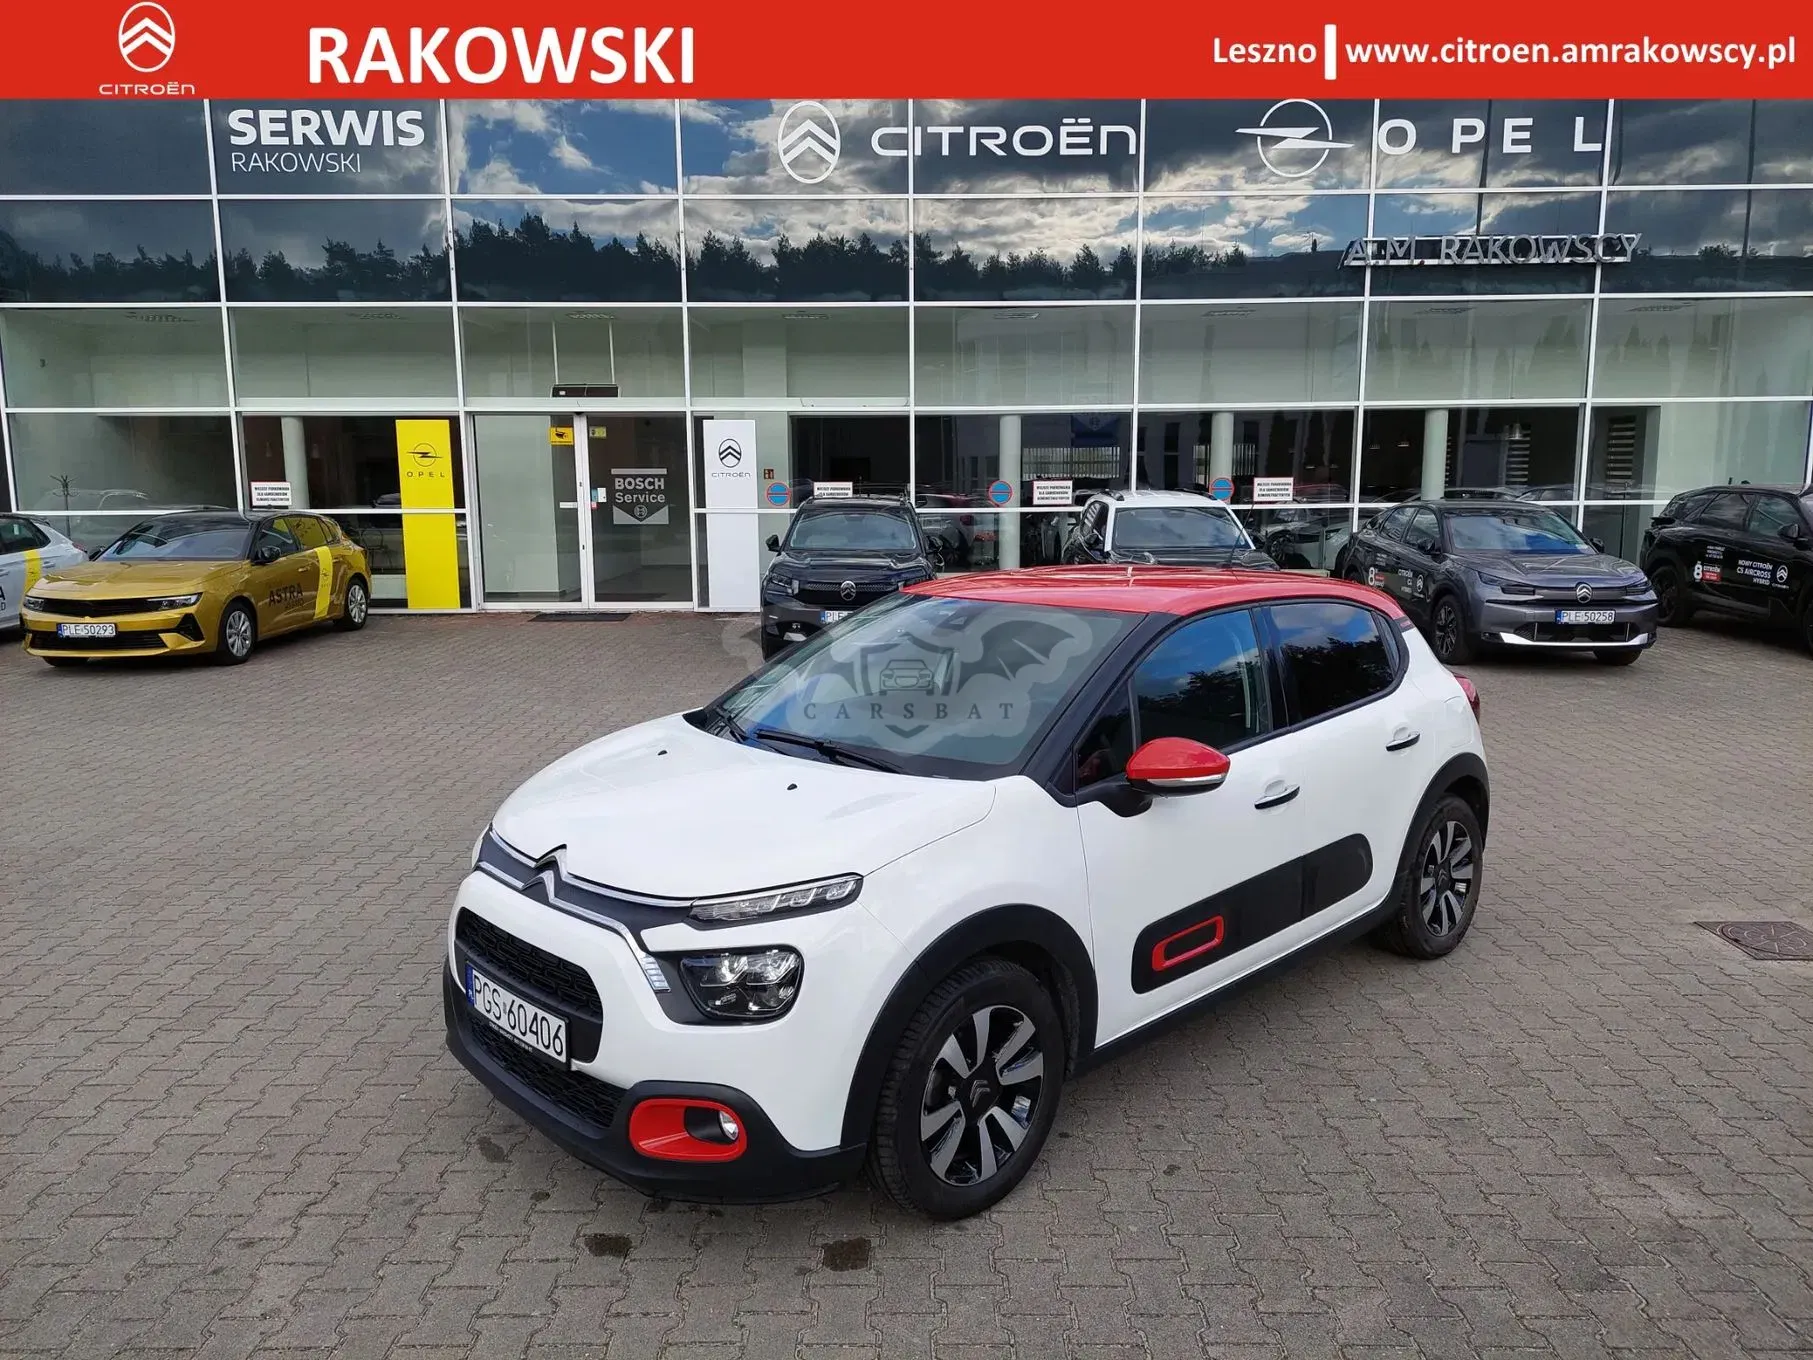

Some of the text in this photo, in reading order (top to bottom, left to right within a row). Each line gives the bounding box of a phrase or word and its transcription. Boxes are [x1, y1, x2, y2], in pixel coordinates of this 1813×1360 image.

[227, 109, 425, 147] SERWIS
[871, 117, 1137, 157] CITROËN
[1377, 116, 1602, 155] OPEL
[231, 152, 361, 173] RAKOWSKI
[1440, 233, 1643, 265] RAKOWSCY
[614, 477, 665, 490] BOSCH
[615, 491, 666, 503] Service
[1368, 566, 1375, 586] 8
[1693, 563, 1702, 580] 8
[1744, 568, 1772, 579] AIRCROSS
[268, 583, 304, 607] ASTRA
[1562, 611, 1614, 622] PLE 50258
[62, 624, 115, 635] PLE 50293
[473, 974, 502, 1021] PGS
[507, 999, 564, 1057] 60406
